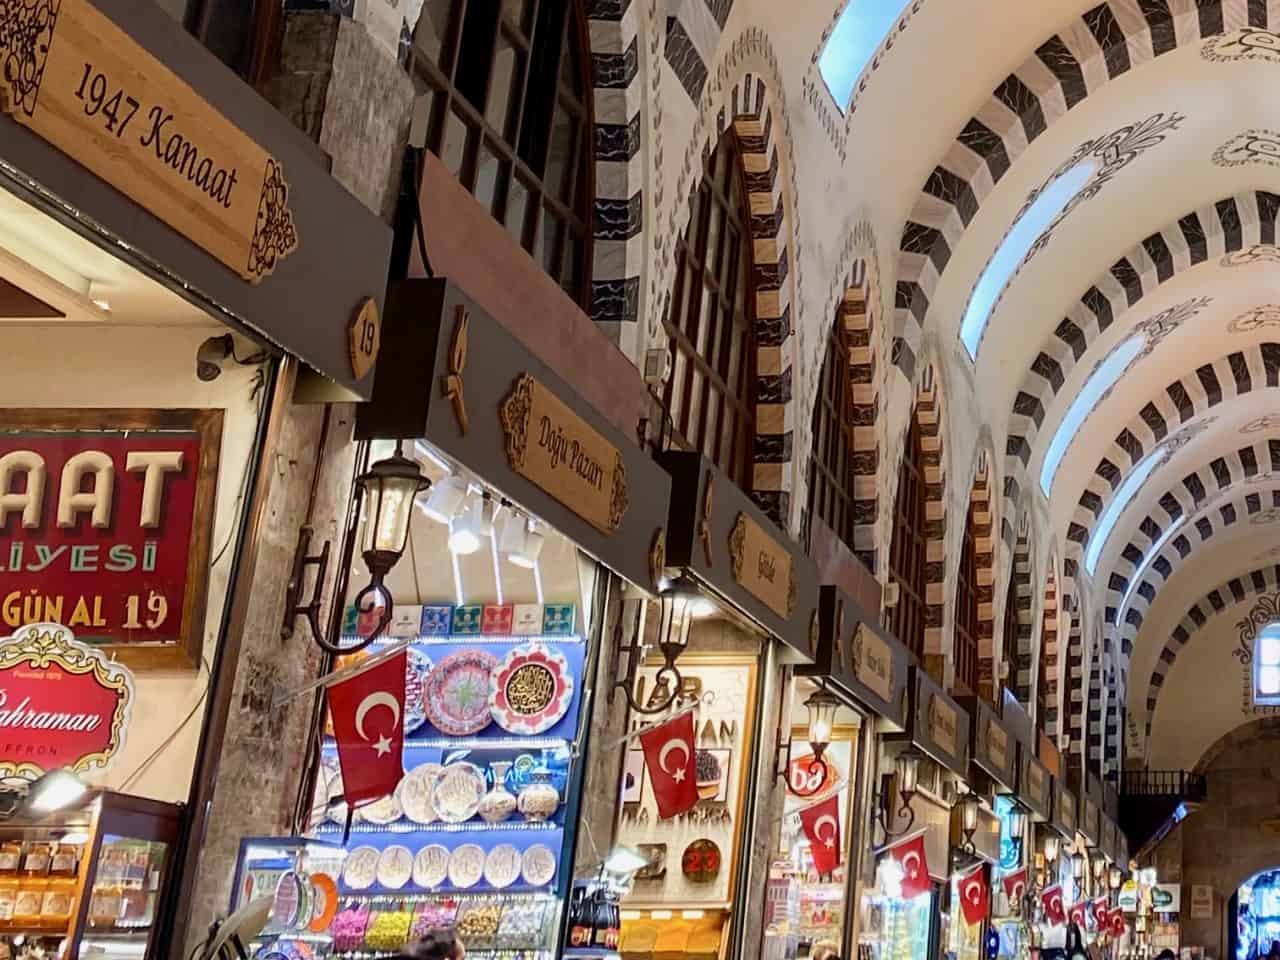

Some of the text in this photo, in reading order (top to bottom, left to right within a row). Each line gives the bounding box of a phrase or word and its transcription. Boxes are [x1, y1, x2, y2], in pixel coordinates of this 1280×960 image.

[74, 63, 239, 209] 1947 Kanaat
[360, 319, 376, 356] 19
[539, 415, 568, 470] Doğu
[0, 541, 157, 572] İYESİ
[122, 590, 168, 630] 19
